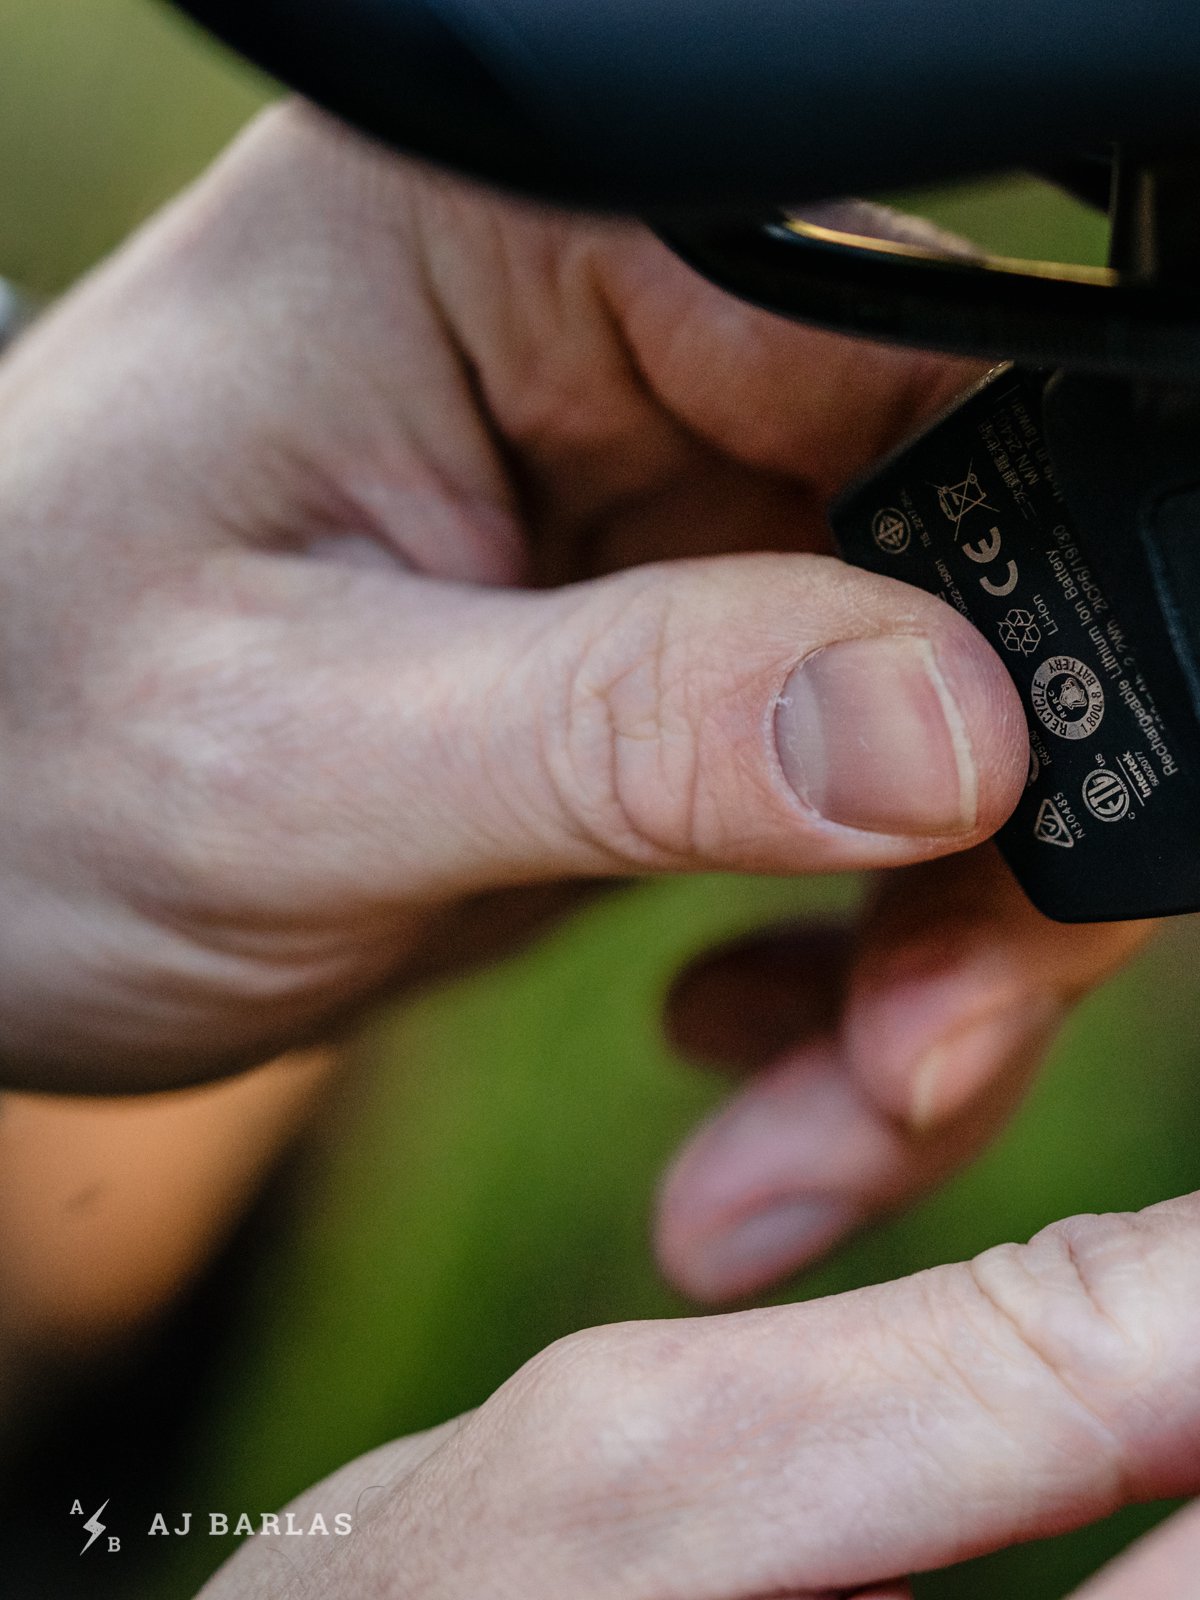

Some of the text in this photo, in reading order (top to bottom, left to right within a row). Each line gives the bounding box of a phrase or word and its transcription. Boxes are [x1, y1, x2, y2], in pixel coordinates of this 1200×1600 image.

[1046, 550, 1078, 600] Battery
[1033, 594, 1058, 635] Li-ion
[1075, 601, 1092, 626] Ion
[1089, 626, 1122, 679] Lithium
[1032, 678, 1068, 737] RECYCLE
[1119, 680, 1178, 776] Rechargeable
[1123, 751, 1151, 798] Intertek
[1054, 792, 1085, 839] N30485
